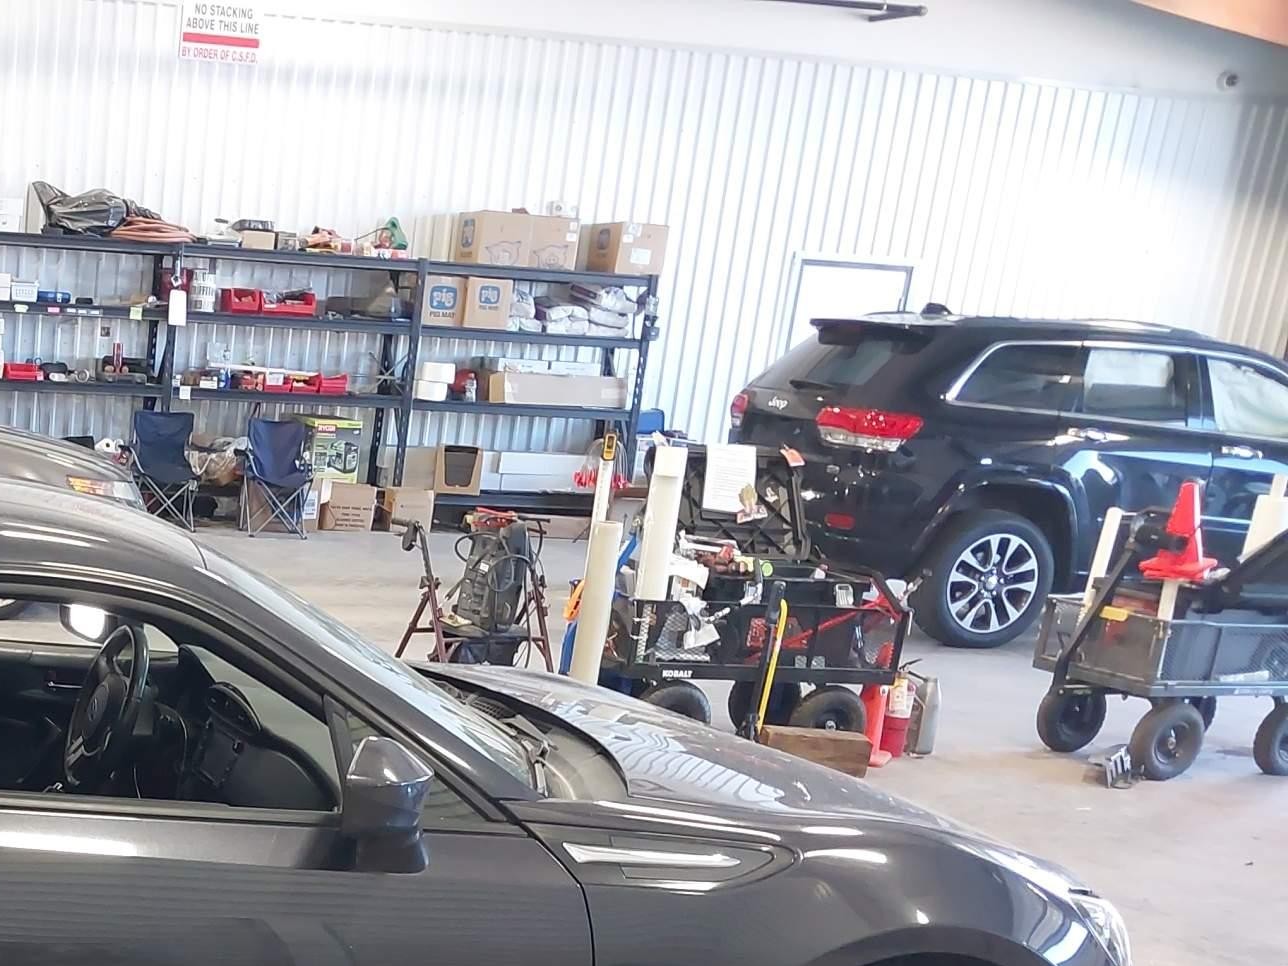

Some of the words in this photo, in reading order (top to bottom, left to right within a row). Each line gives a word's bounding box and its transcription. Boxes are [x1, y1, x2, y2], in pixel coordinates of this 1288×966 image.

[195, 3, 207, 15] NO
[210, 4, 253, 20] STACKING
[186, 17, 215, 31] ABOVE
[218, 19, 238, 33] THIS
[240, 23, 260, 34] LINE
[181, 46, 191, 57] BY
[193, 47, 218, 60] ORDER
[220, 49, 231, 60] OF
[662, 669, 693, 678] KOBALT
